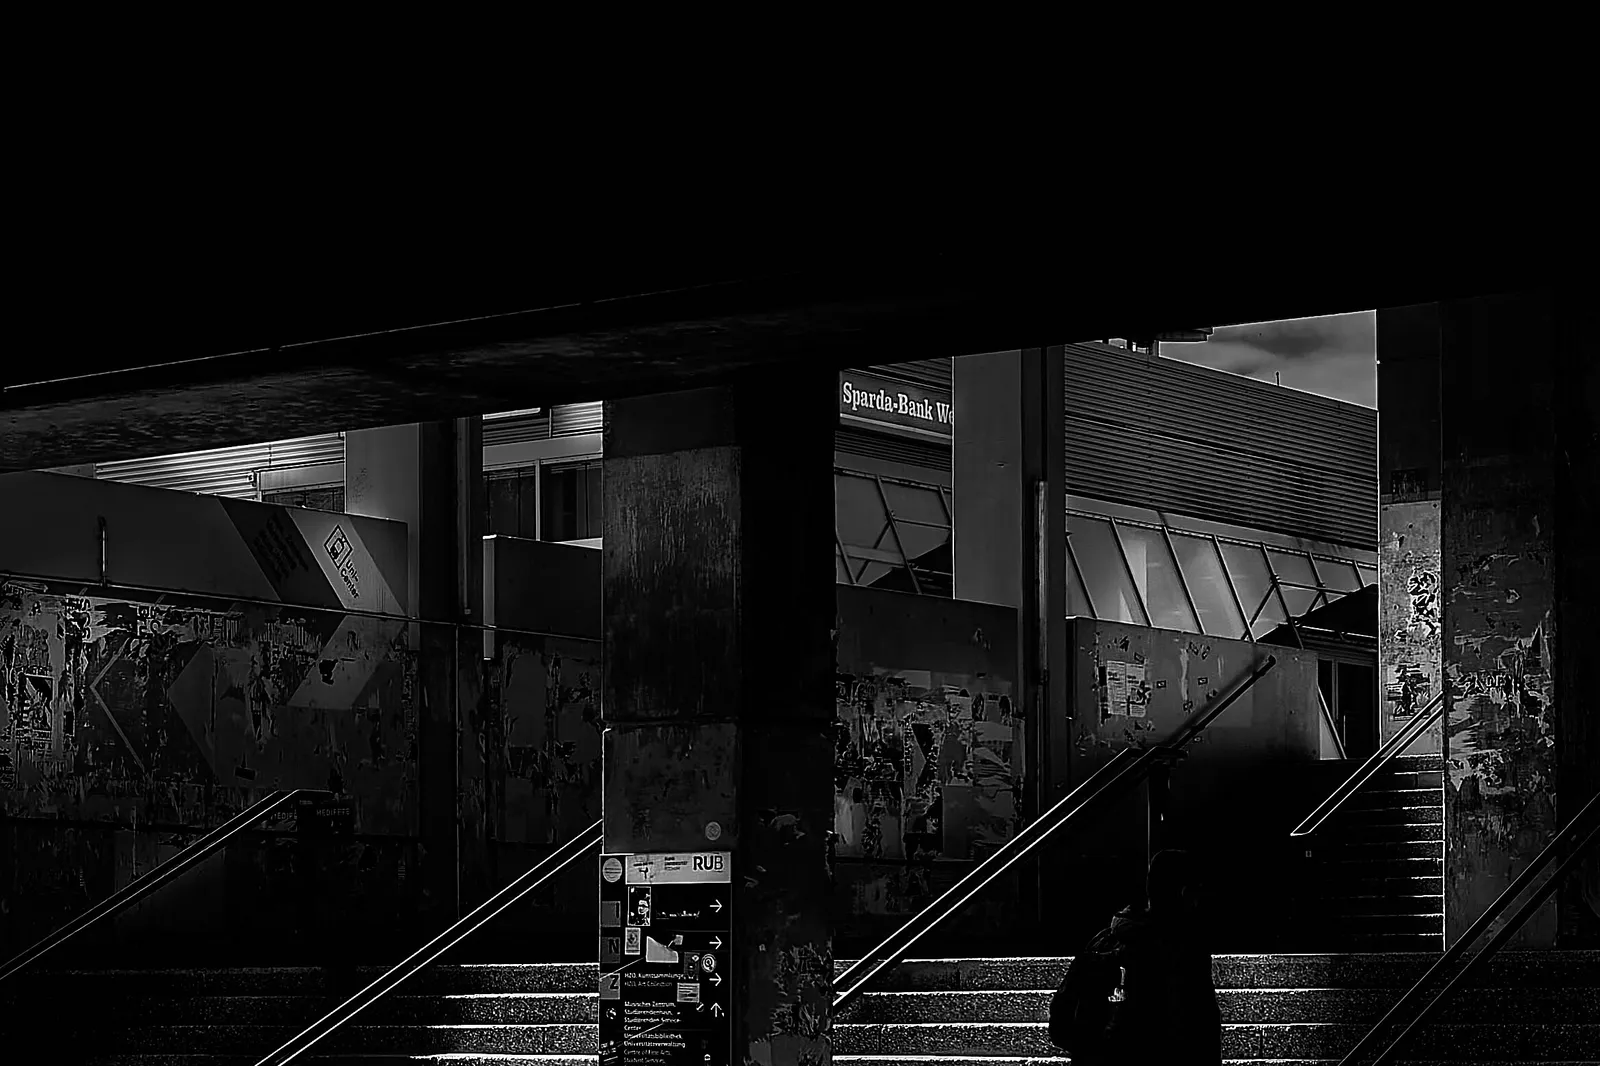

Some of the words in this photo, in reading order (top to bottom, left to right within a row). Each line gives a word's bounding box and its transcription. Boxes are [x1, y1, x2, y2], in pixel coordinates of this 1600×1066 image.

[843, 382, 933, 420] Sparda-Bank
[340, 568, 360, 599] Center
[693, 855, 723, 871] RUB
